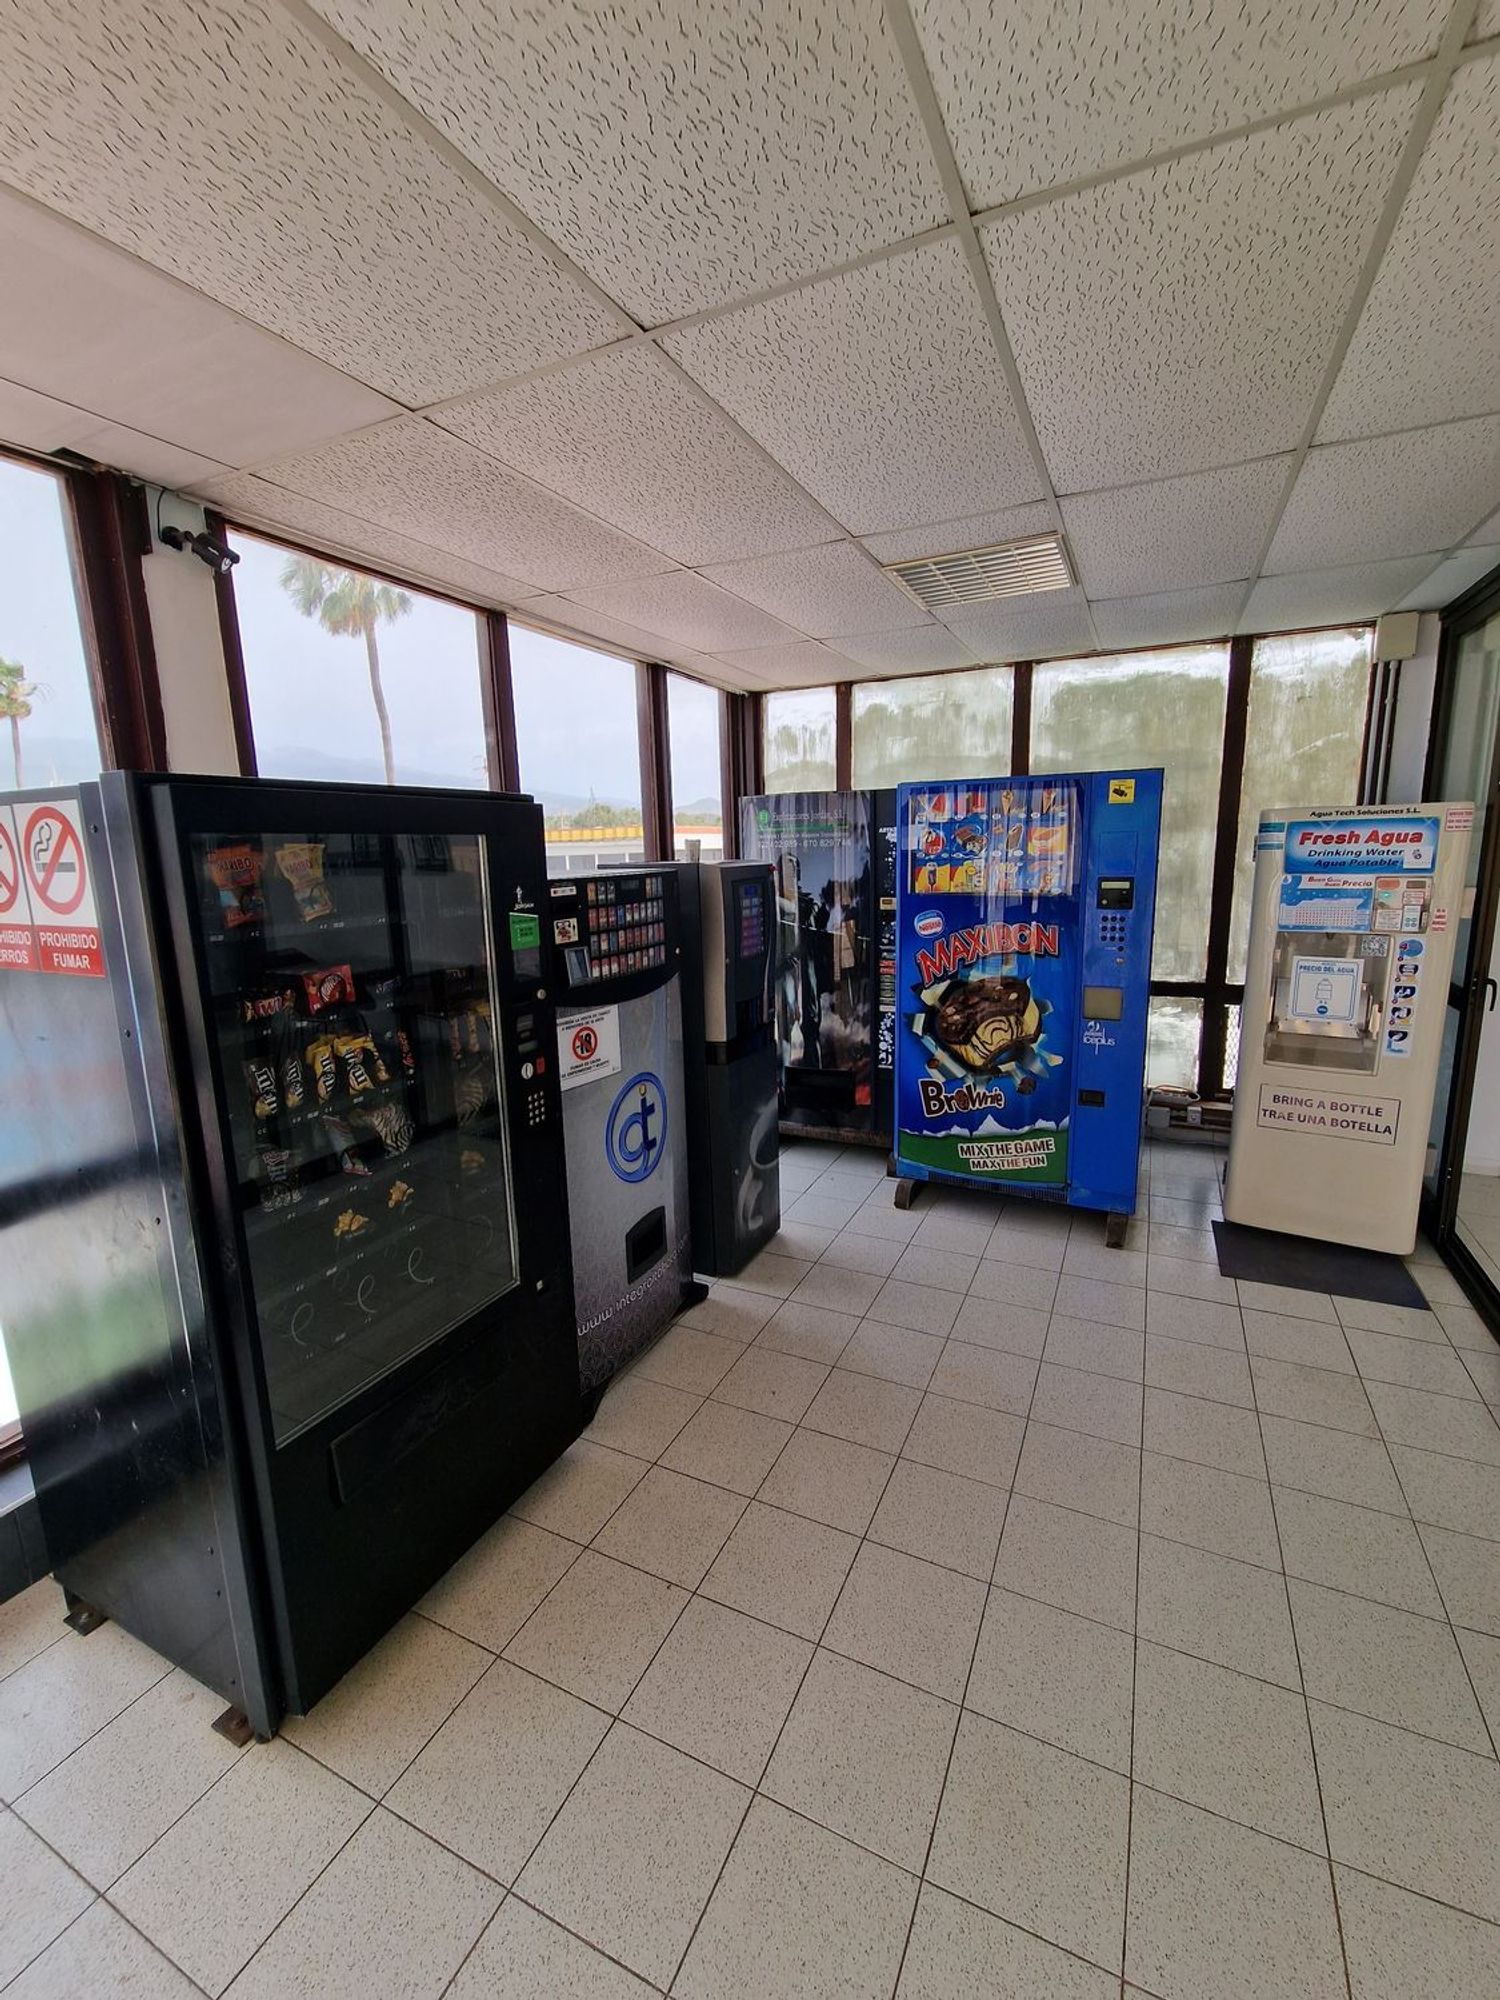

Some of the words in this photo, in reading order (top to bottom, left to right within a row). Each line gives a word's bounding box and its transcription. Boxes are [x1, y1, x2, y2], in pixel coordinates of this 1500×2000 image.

[1357, 808, 1404, 816] Soluciones
[1299, 830, 1360, 846] Fresh
[1364, 829, 1424, 847] Agua
[1308, 849, 1362, 858] Drinking
[1366, 848, 1405, 857] Water
[1314, 860, 1346, 869] Agua
[1349, 859, 1400, 867] Potable
[40, 932, 97, 949] PROHIBIDO
[53, 953, 90, 968] FUMAR
[916, 921, 1060, 987] MAXIBON
[919, 1078, 1006, 1117] Brownie
[1272, 1094, 1313, 1108] BRING
[1316, 1100, 1326, 1110] A
[1330, 1101, 1383, 1117] BOTTLE
[1262, 1108, 1295, 1121] TRAE
[1297, 1113, 1326, 1126] UNA
[1330, 1117, 1392, 1135] BOTELLA
[959, 1142, 987, 1157] MIX
[987, 1140, 1013, 1155] THE
[1014, 1137, 1055, 1154] GAME
[972, 1158, 999, 1170] MAX
[999, 1157, 1022, 1169] THE
[1023, 1155, 1046, 1167] FUN
